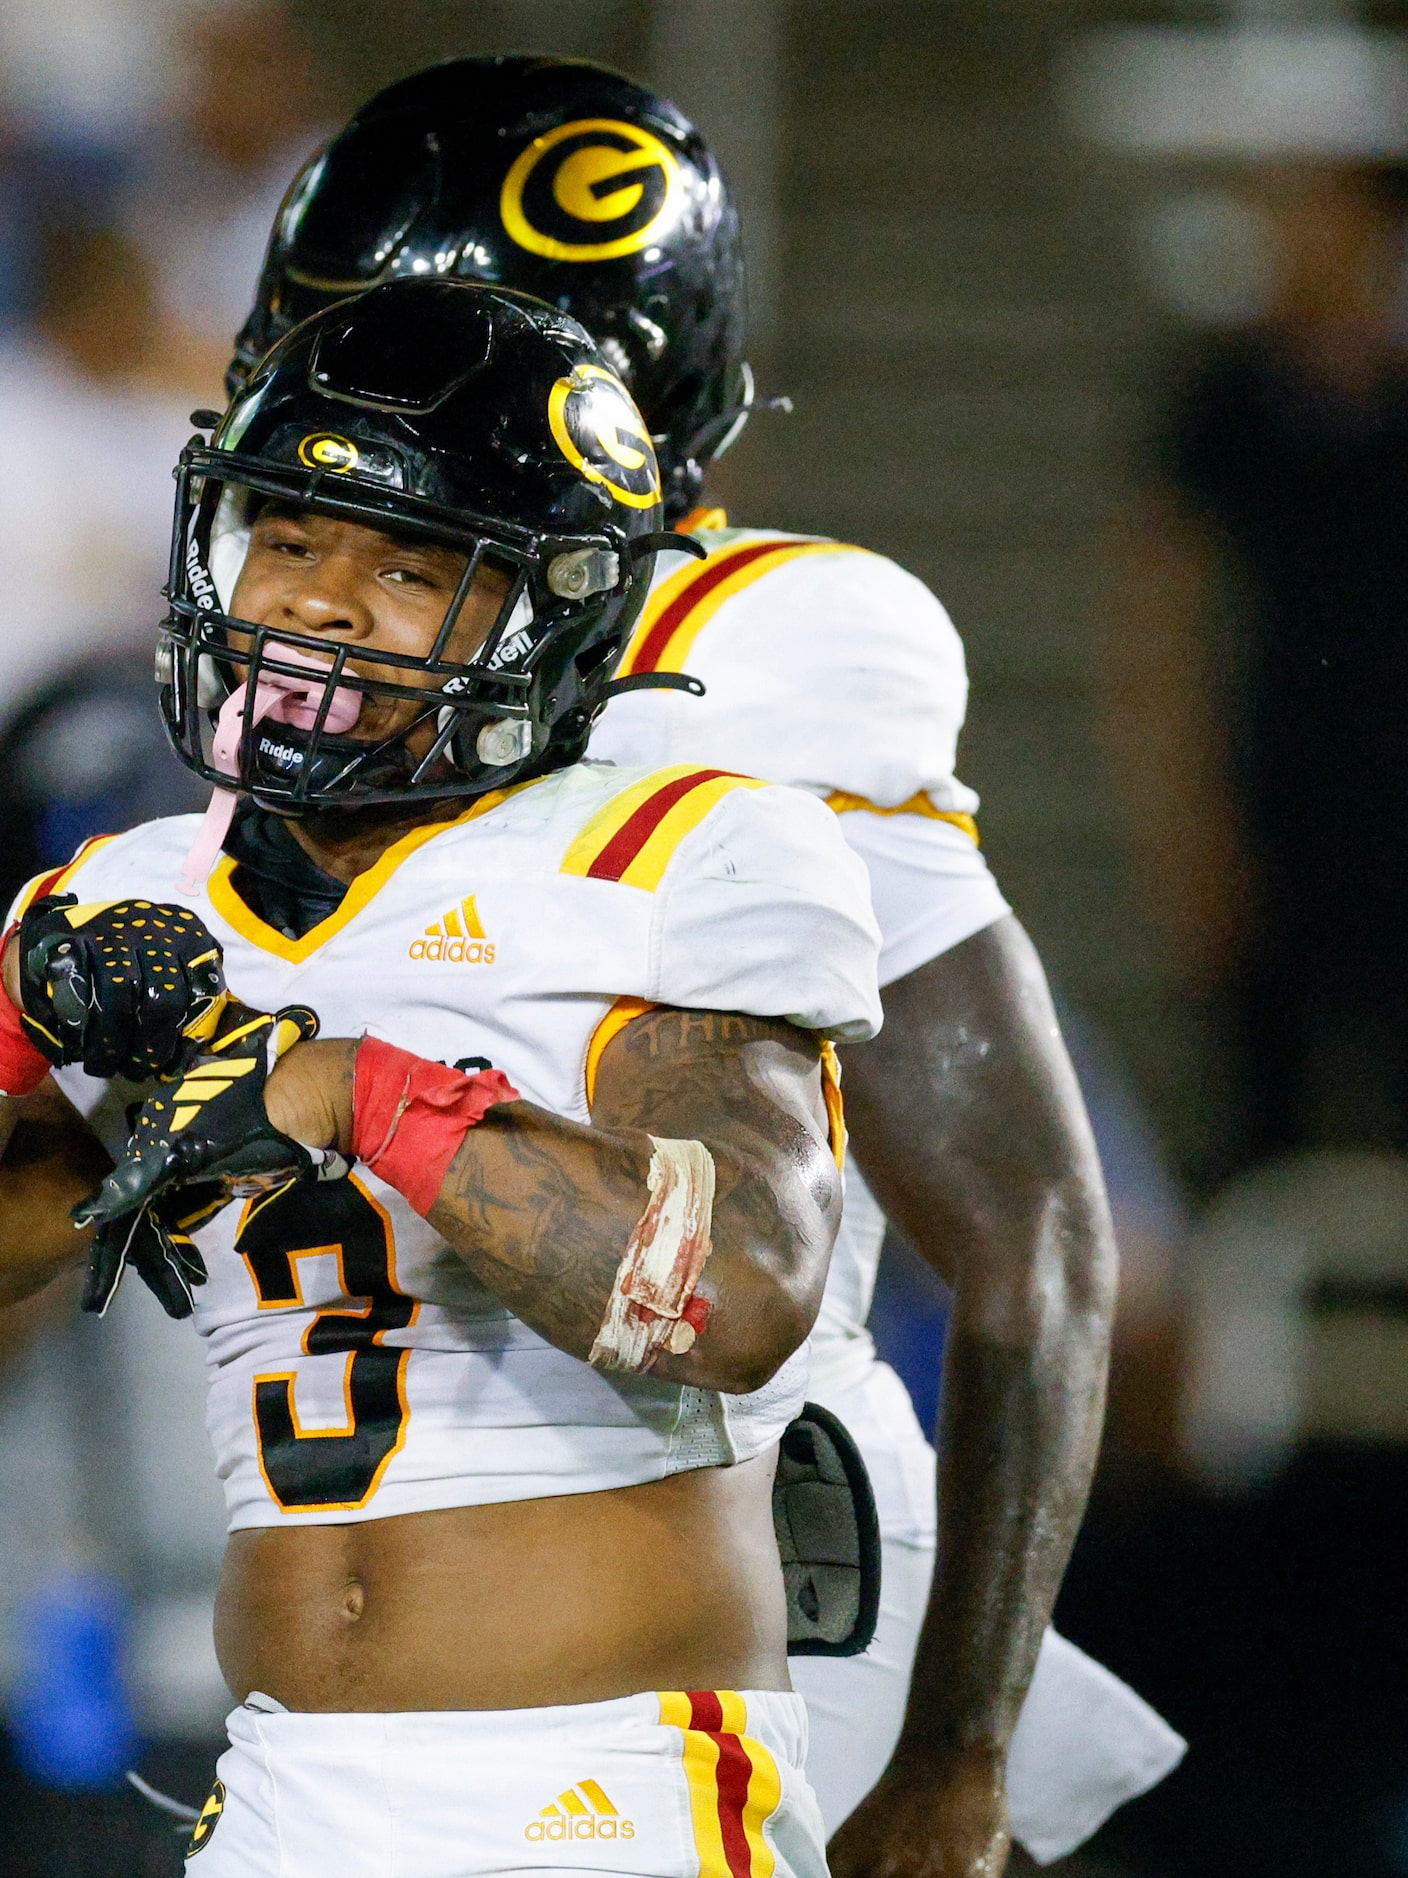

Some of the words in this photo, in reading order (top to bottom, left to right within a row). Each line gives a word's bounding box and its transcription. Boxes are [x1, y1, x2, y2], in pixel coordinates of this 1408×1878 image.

[500, 118, 684, 262] G
[298, 432, 359, 474] G
[548, 364, 663, 509] G
[186, 537, 221, 635] Ridde
[259, 737, 306, 764] Ridde
[409, 935, 496, 965] adidas
[234, 1163, 421, 1515] 3
[524, 1814, 636, 1841] adidas
